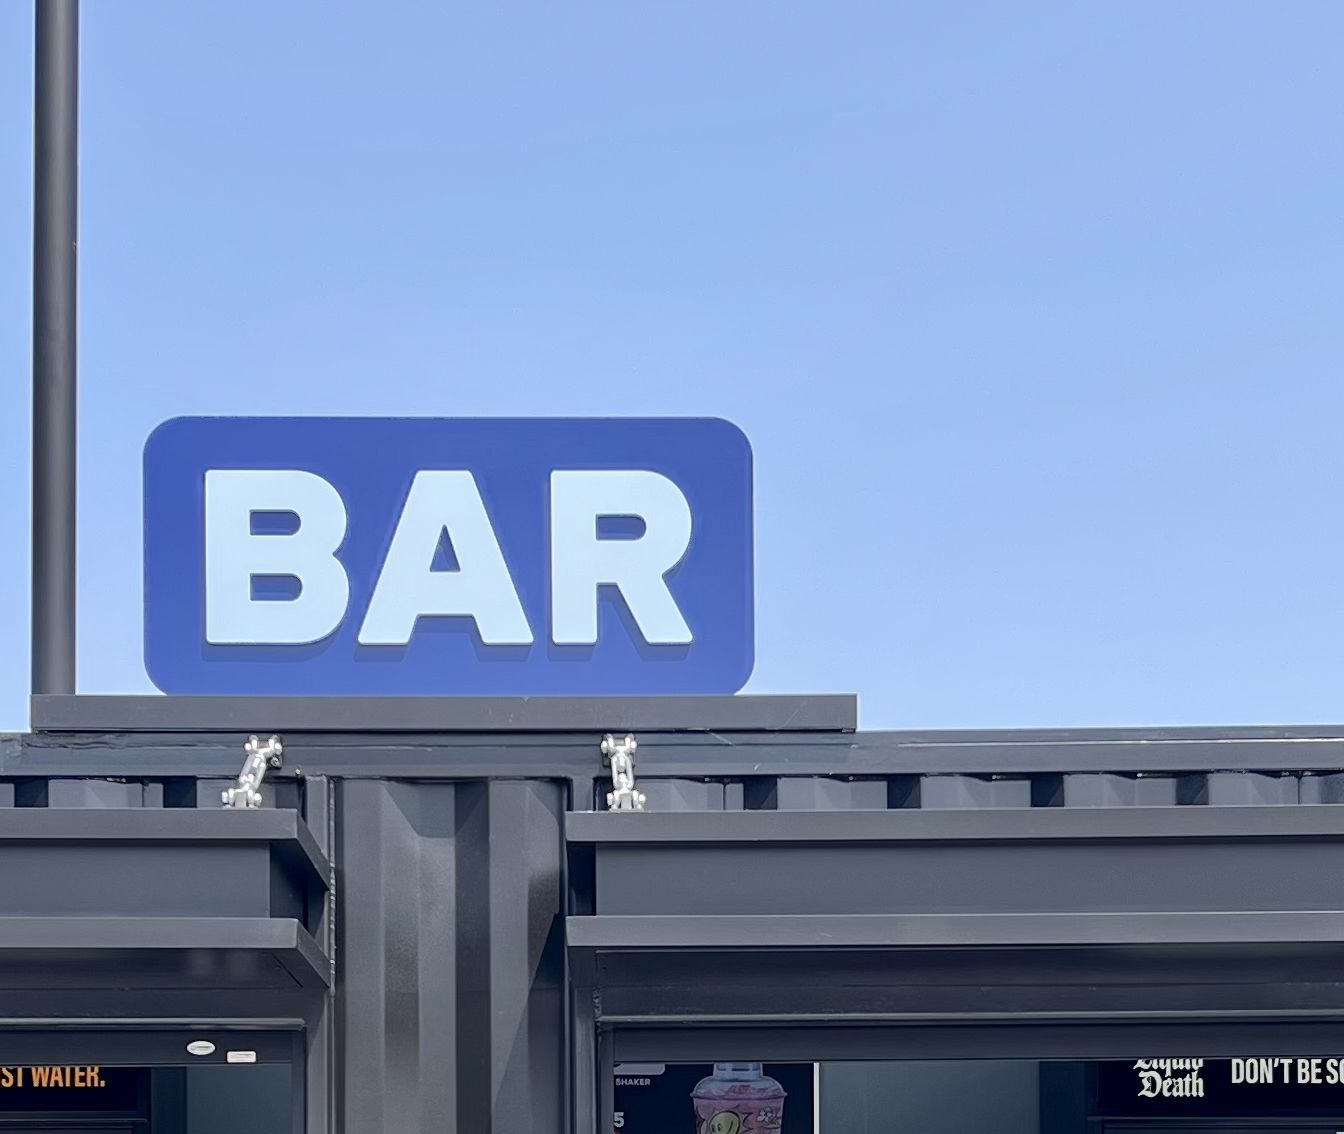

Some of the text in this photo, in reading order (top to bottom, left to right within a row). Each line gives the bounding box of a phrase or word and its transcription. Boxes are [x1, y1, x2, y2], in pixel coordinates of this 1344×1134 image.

[204, 468, 693, 646] BAR
[1137, 1071, 1205, 1098] Death
[1230, 1058, 1292, 1084] DON'T
[1297, 1058, 1323, 1084] BE
